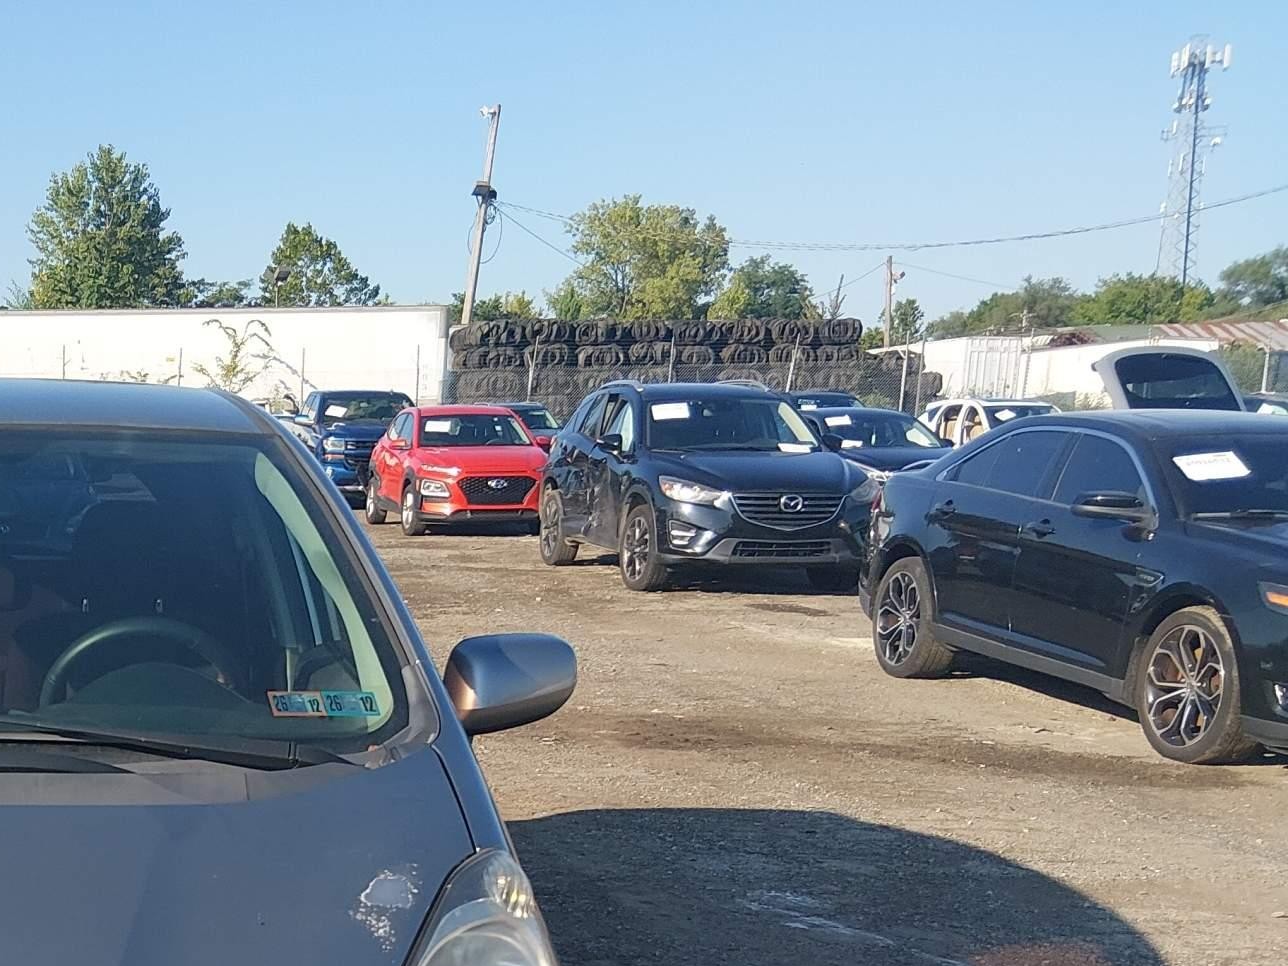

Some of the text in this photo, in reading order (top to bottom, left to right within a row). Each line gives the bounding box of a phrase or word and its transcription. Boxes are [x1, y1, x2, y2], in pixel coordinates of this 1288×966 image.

[274, 695, 321, 712] 26 12
[327, 695, 375, 712] 26 12
